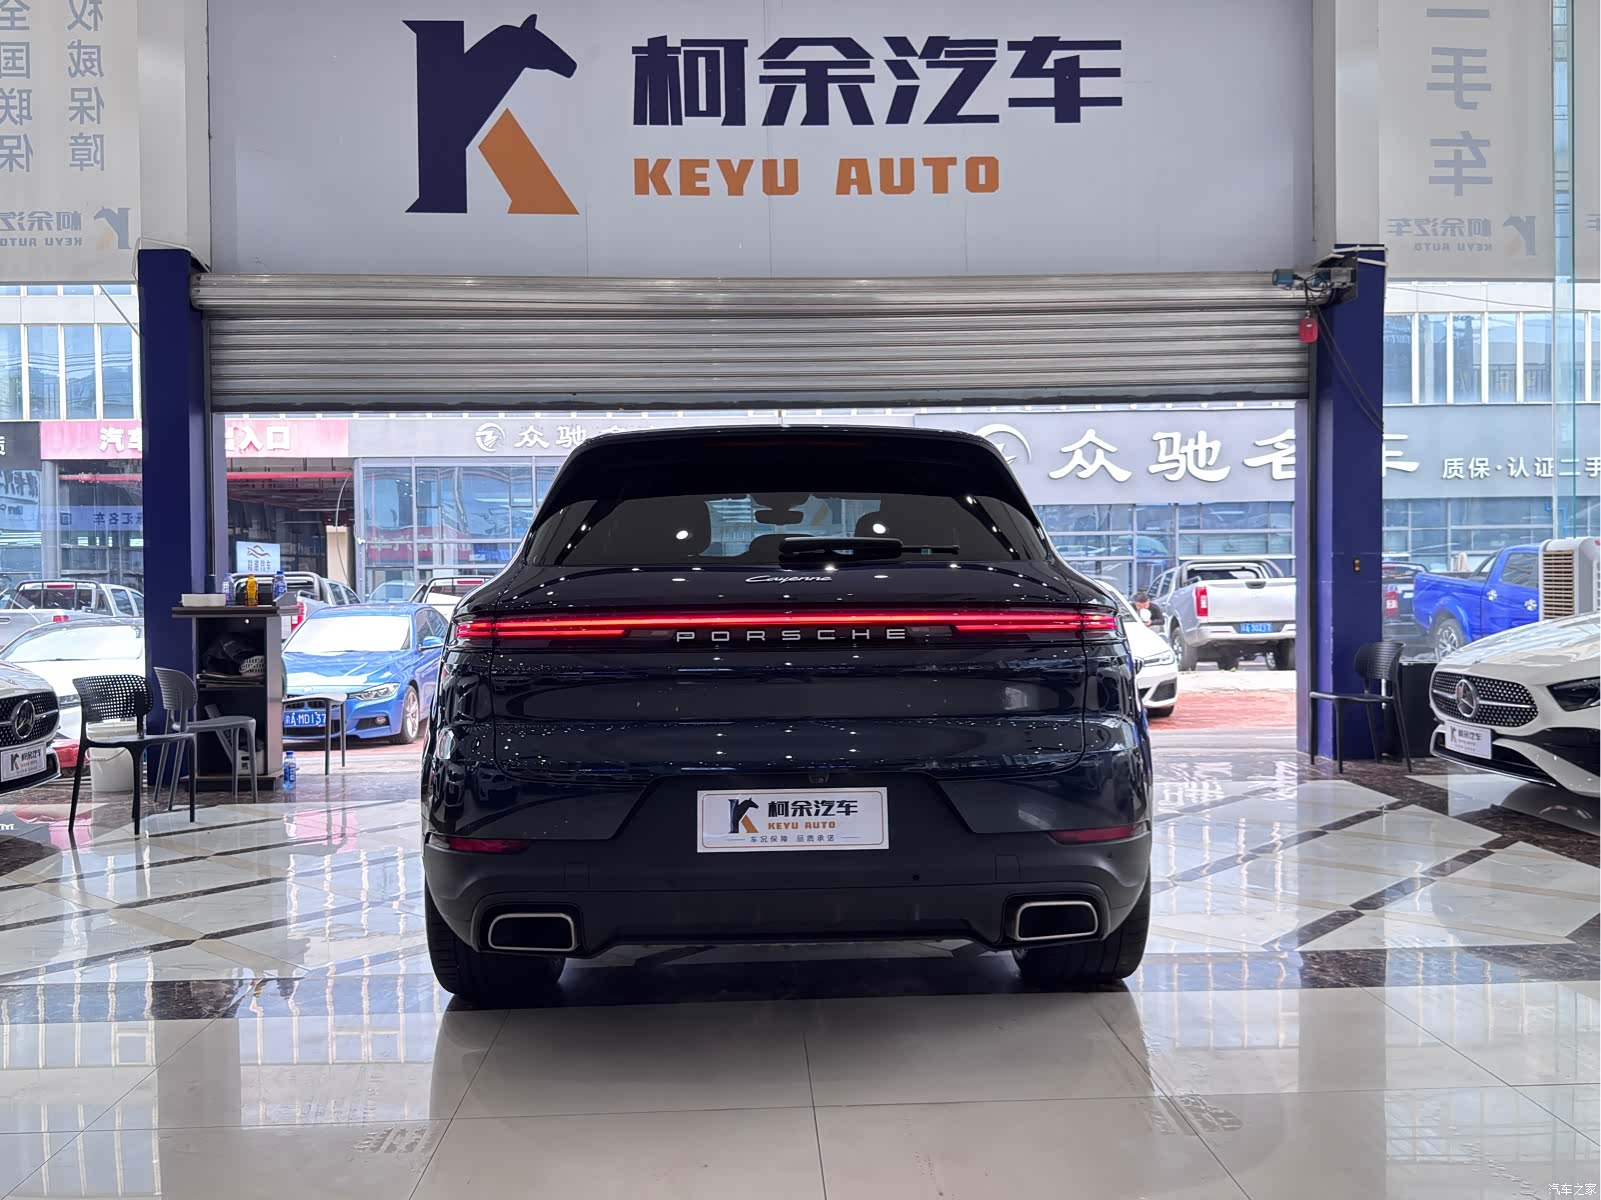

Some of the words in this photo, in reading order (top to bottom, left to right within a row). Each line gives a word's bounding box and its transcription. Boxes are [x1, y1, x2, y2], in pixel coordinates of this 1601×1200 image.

[631, 35, 1123, 127] 柯余汽车
[633, 157, 799, 197] KEYU
[836, 156, 1000, 196] AUTO
[745, 574, 833, 585] Cayenne
[676, 628, 907, 643] PORSCHE
[767, 800, 859, 818] 柯余汽车
[768, 821, 799, 830] KEYU
[805, 820, 836, 830] AUTO
[750, 836, 788, 844] 车况保障
